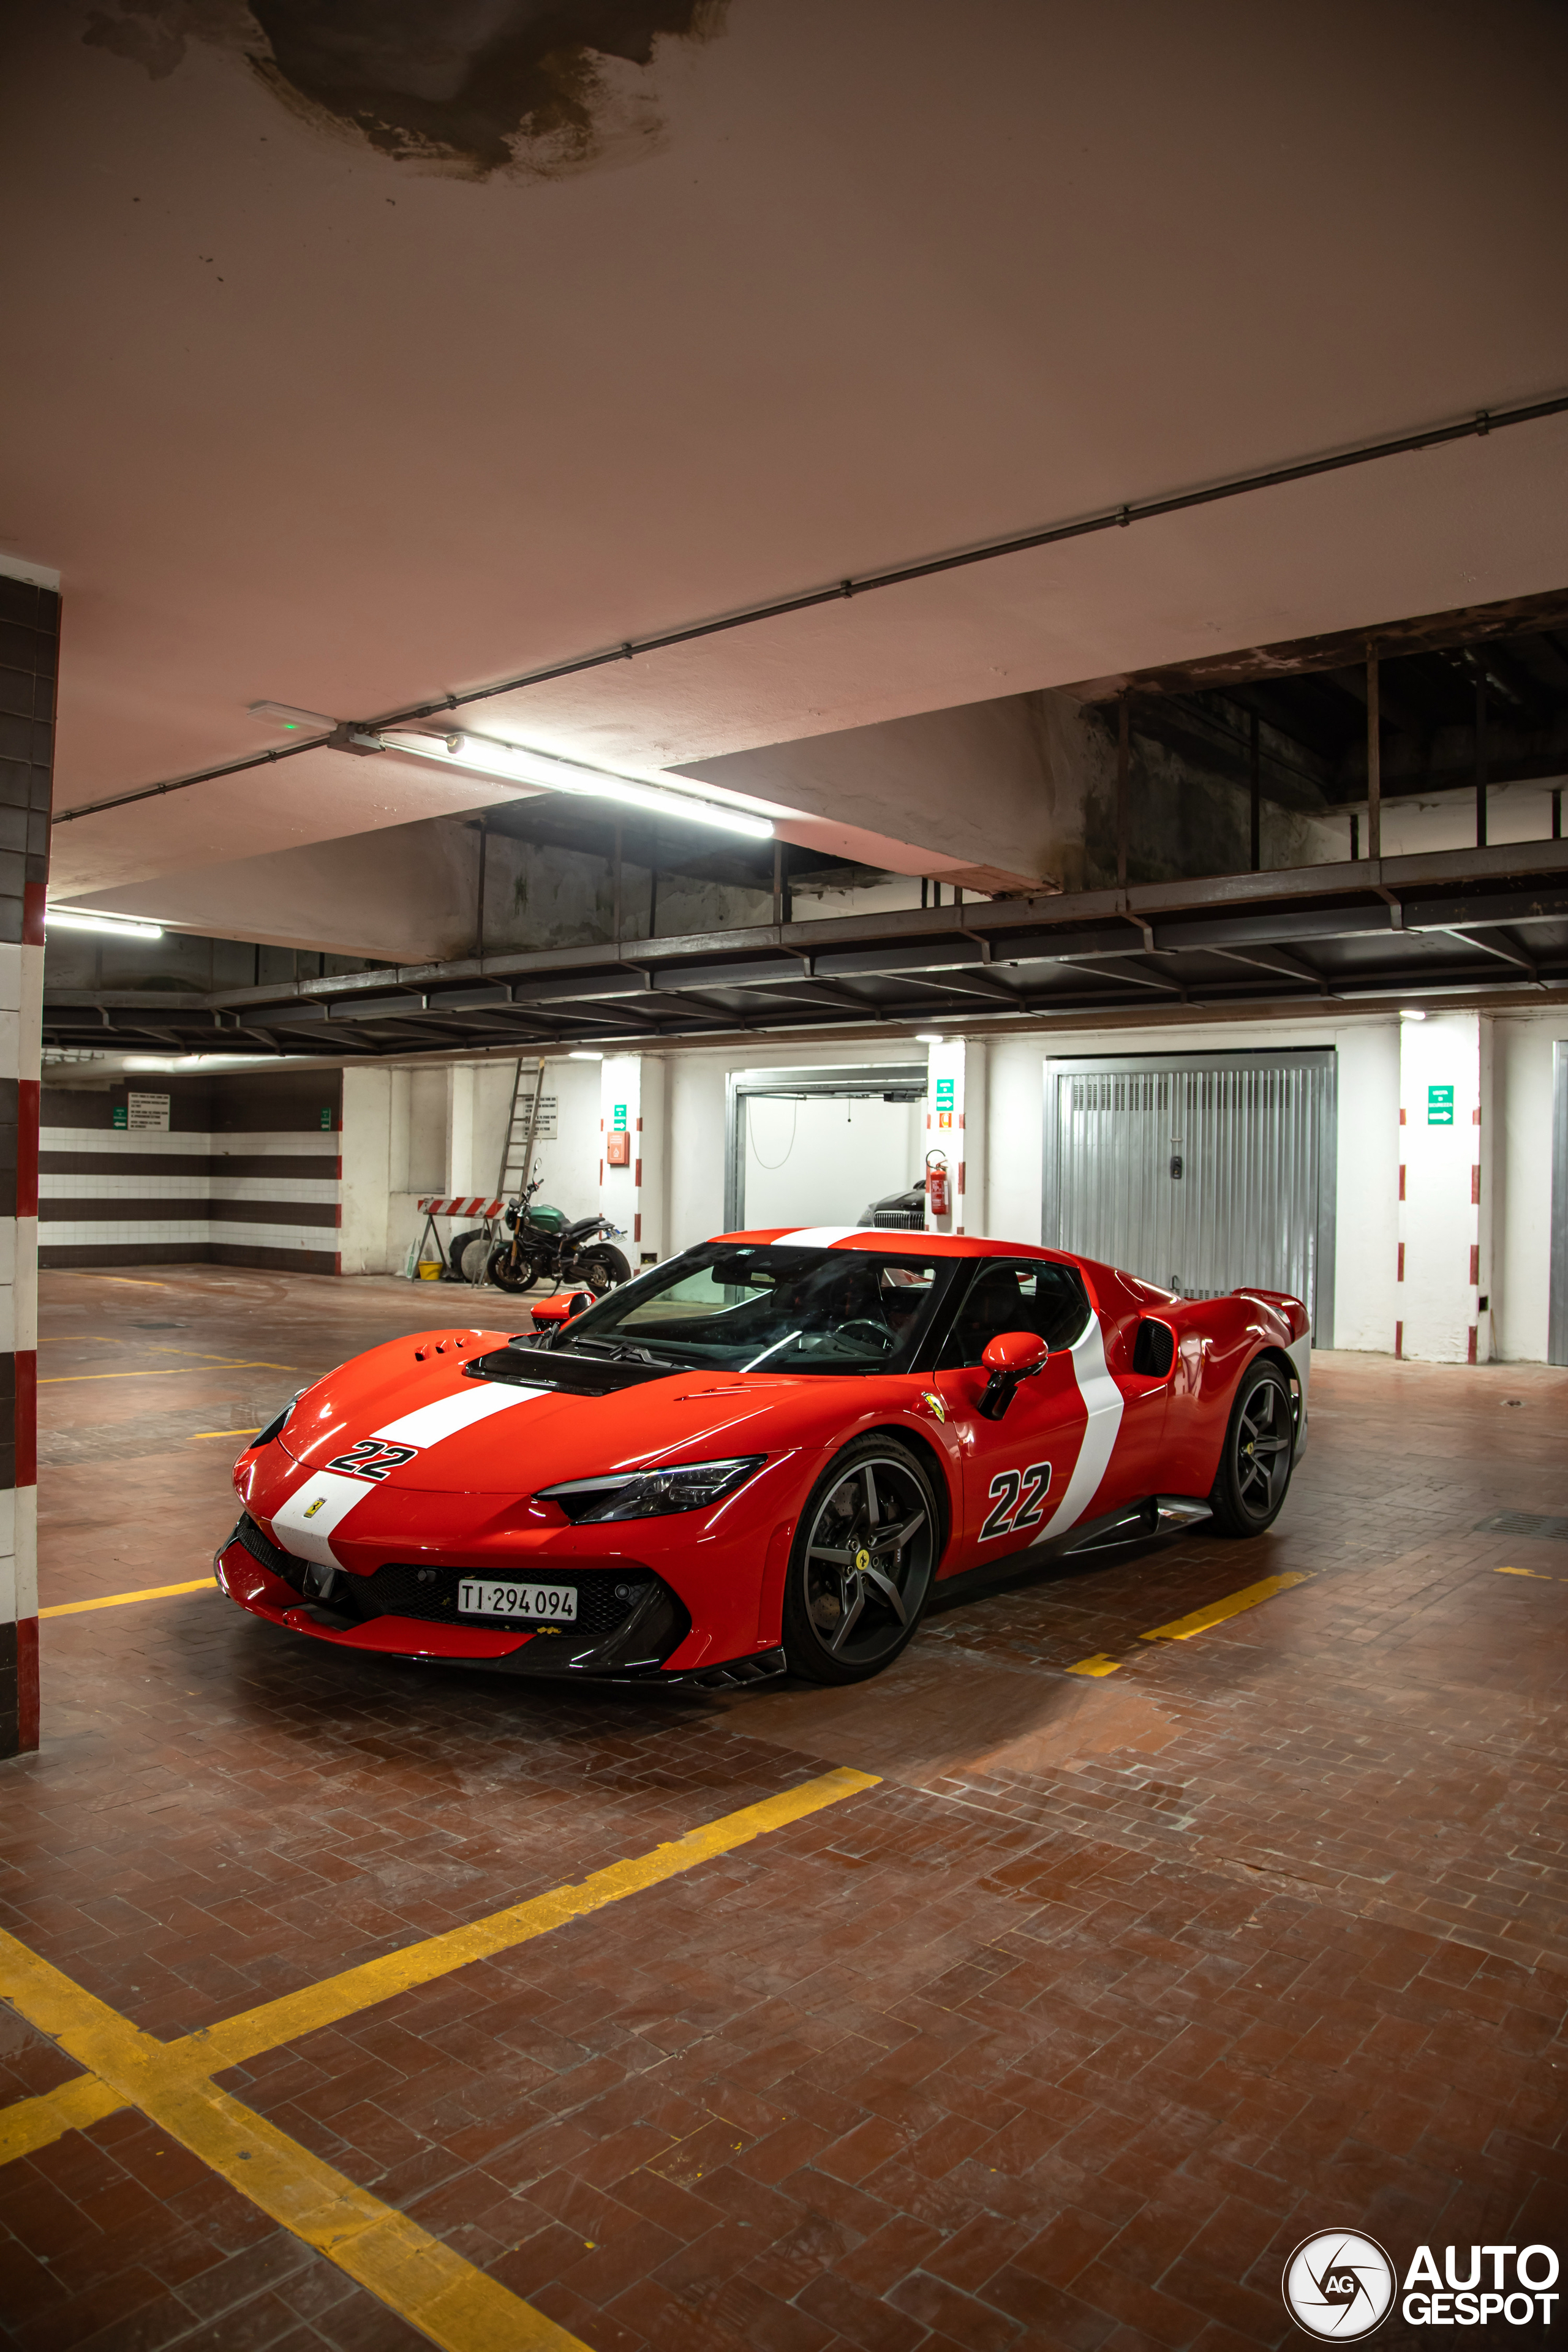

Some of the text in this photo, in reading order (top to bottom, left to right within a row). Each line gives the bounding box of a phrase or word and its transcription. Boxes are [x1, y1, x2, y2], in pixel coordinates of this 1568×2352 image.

[325, 1439, 418, 1481] 22
[978, 1461, 1052, 1543] 22
[462, 1585, 573, 1616] TI 294 094
